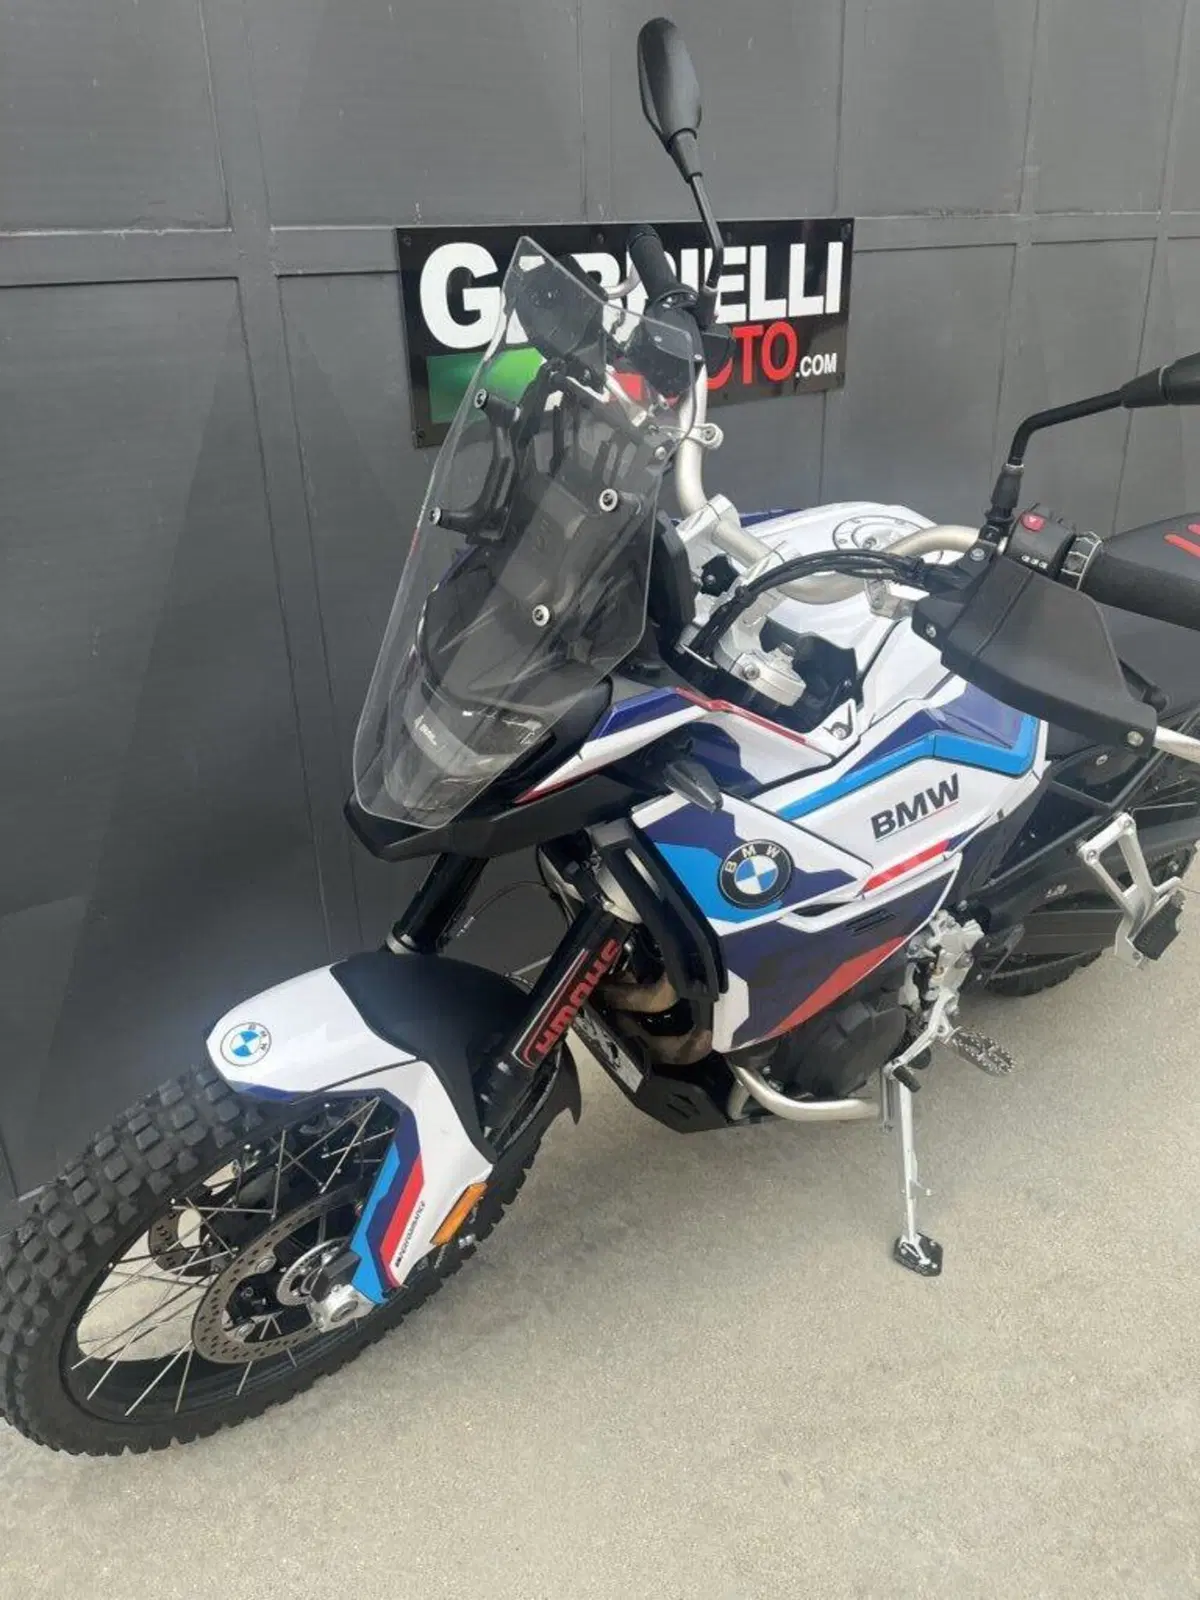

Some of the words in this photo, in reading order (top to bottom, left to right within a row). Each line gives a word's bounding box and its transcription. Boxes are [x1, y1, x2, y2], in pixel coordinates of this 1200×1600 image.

[420, 241, 844, 349] GBIELLI
[795, 353, 838, 379] .COM
[870, 774, 960, 839] BMW
[724, 844, 780, 873] BMW
